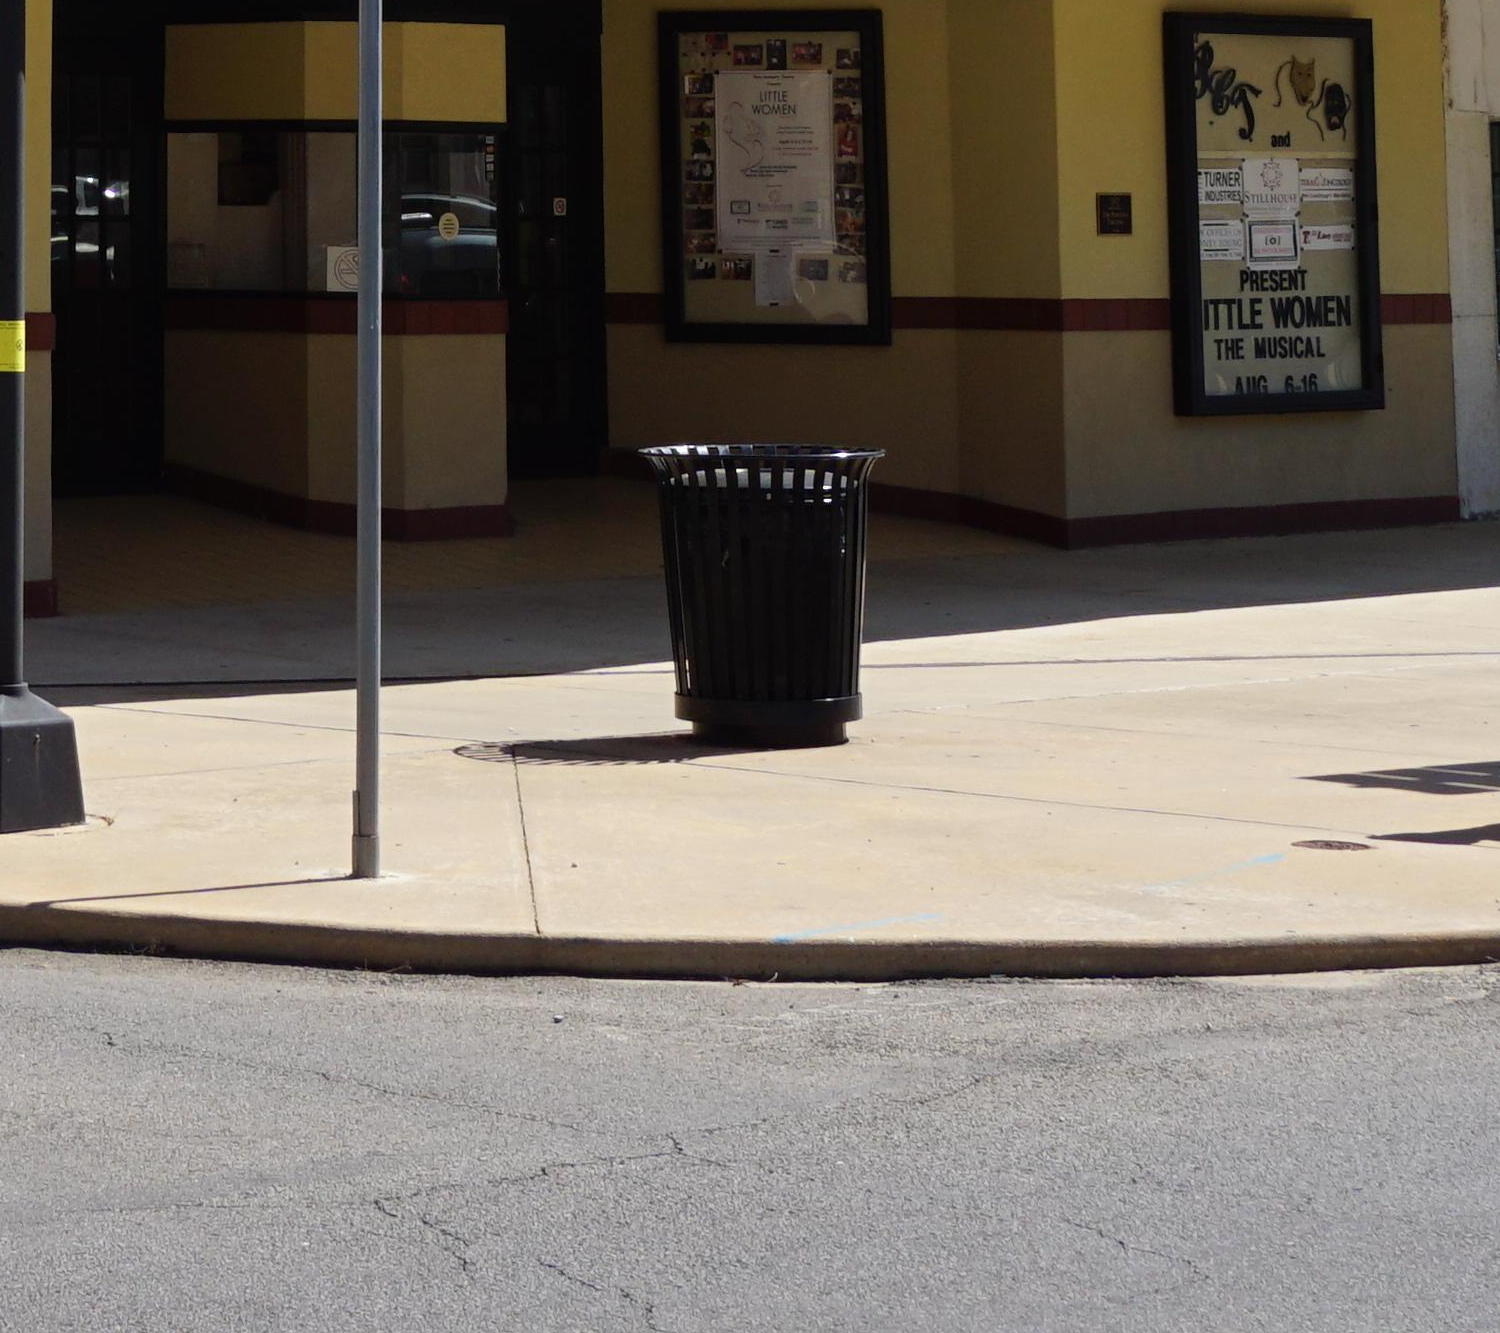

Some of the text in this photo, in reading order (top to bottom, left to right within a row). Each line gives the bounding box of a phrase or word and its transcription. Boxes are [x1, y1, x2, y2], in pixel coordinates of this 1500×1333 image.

[759, 90, 788, 103] LITTLE
[751, 104, 797, 116] WOMEN
[1271, 133, 1291, 149] and
[1204, 171, 1241, 187] TURNER
[1205, 189, 1242, 202] INDUSTRIES
[1243, 190, 1298, 204] STILLHOUSE
[1240, 270, 1308, 292] PRESENT
[1203, 295, 1352, 331] ITTLE WOMEN
[1214, 336, 1327, 361] THE MUSICAL
[1235, 375, 1269, 395] AUG
